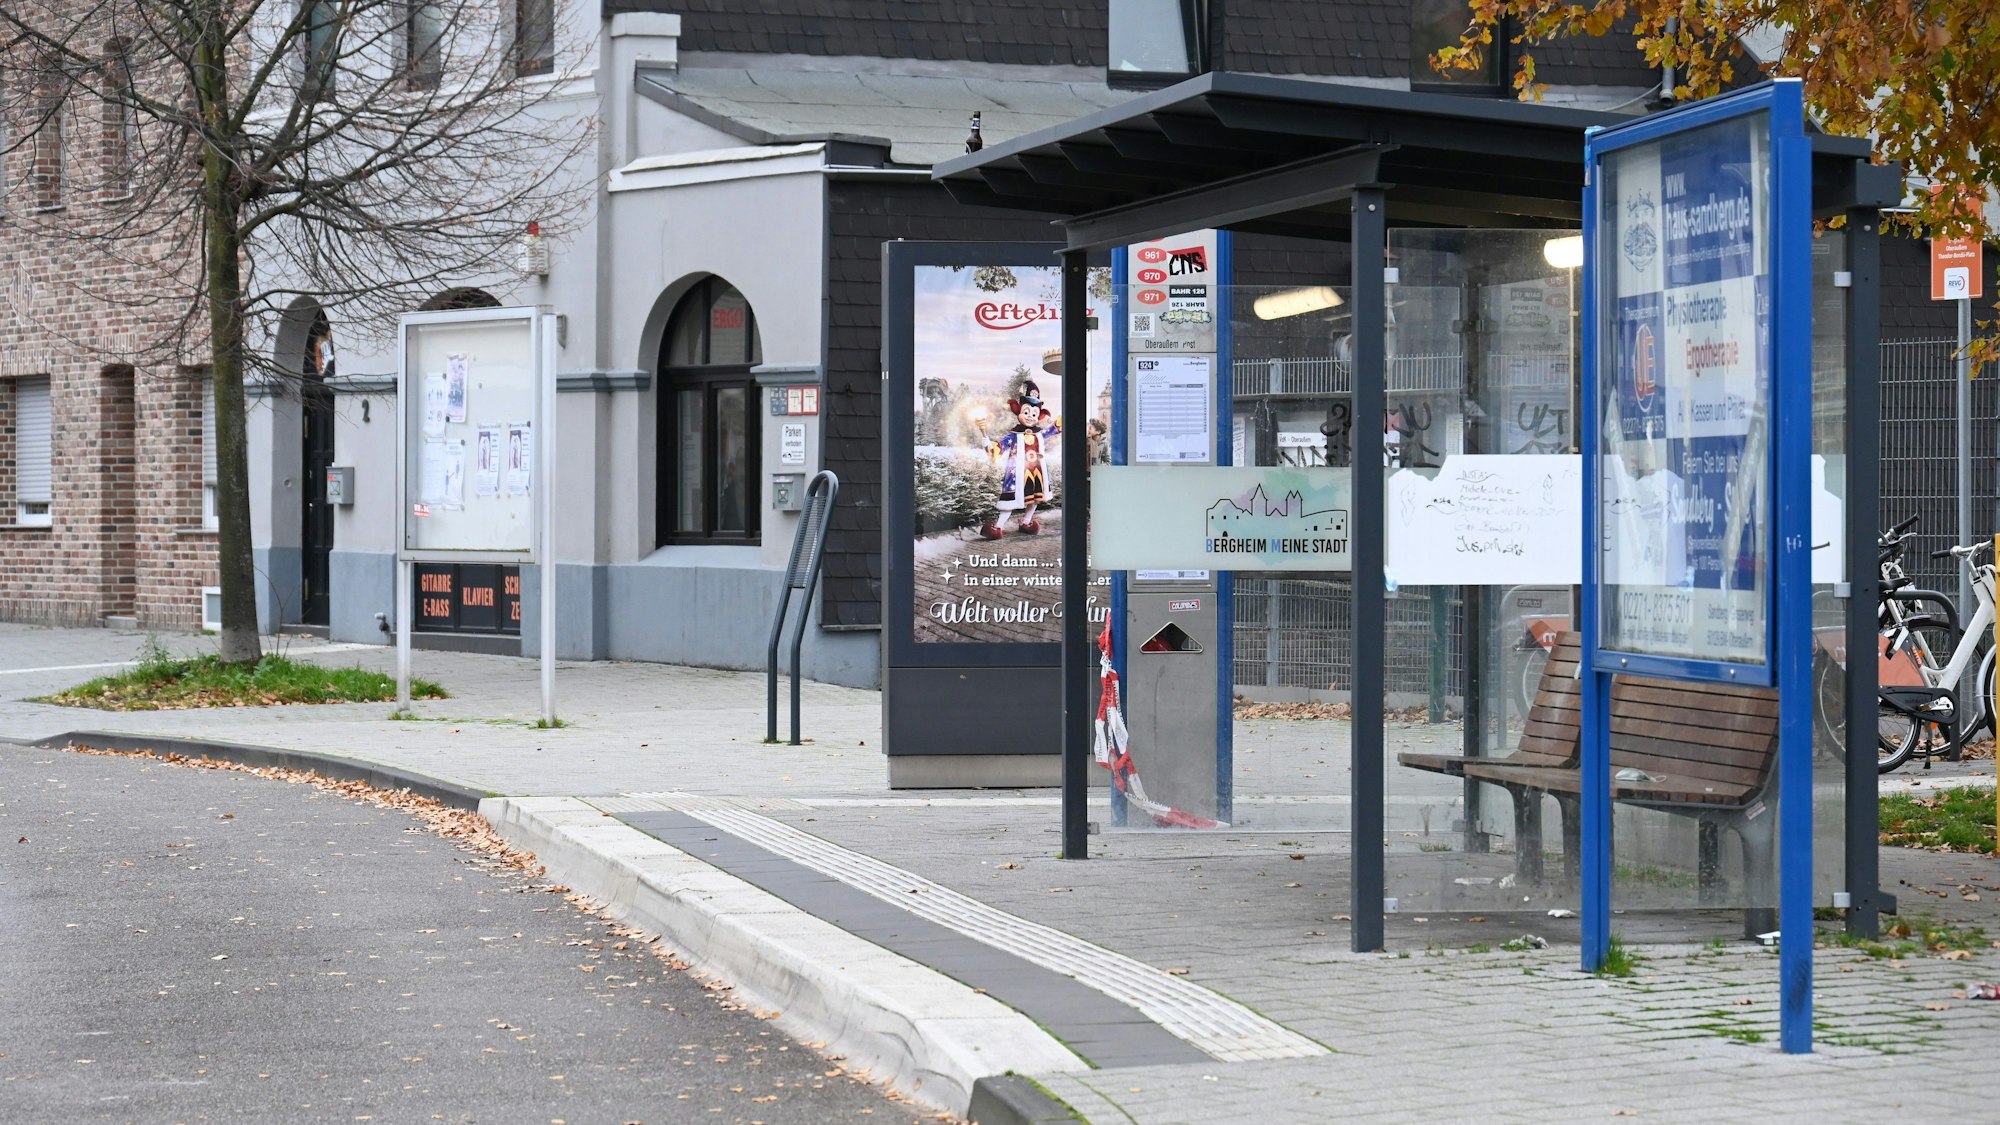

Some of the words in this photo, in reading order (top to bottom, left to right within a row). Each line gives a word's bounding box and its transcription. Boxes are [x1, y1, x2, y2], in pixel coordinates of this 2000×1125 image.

[1666, 187, 1750, 241] haus-sandberg.de
[1144, 251, 1160, 260] 961
[1144, 271, 1160, 280] 970
[1144, 292, 1160, 301] 971
[713, 307, 743, 329] ERGO
[1667, 287, 1727, 334] Physiotherapie
[1145, 340, 1179, 349] Oberaußem
[1686, 333, 1740, 378] Ergotherapie
[785, 426, 802, 438] Parken
[1206, 538, 1267, 553] BERGHEIM
[1271, 538, 1308, 553] MEINE
[1312, 538, 1348, 553] STADT
[969, 554, 998, 568] Und
[1002, 554, 1038, 568] dann
[421, 573, 452, 593] GITARRE
[505, 576, 520, 595] SCH
[964, 573, 978, 586] in
[982, 573, 1018, 586] einer
[463, 587, 494, 607] KLAVIER
[1623, 592, 1648, 621] 02271
[423, 598, 450, 617] E-BASS
[511, 602, 520, 620] ZE
[929, 596, 991, 624] Welt
[993, 600, 1049, 624] voller
